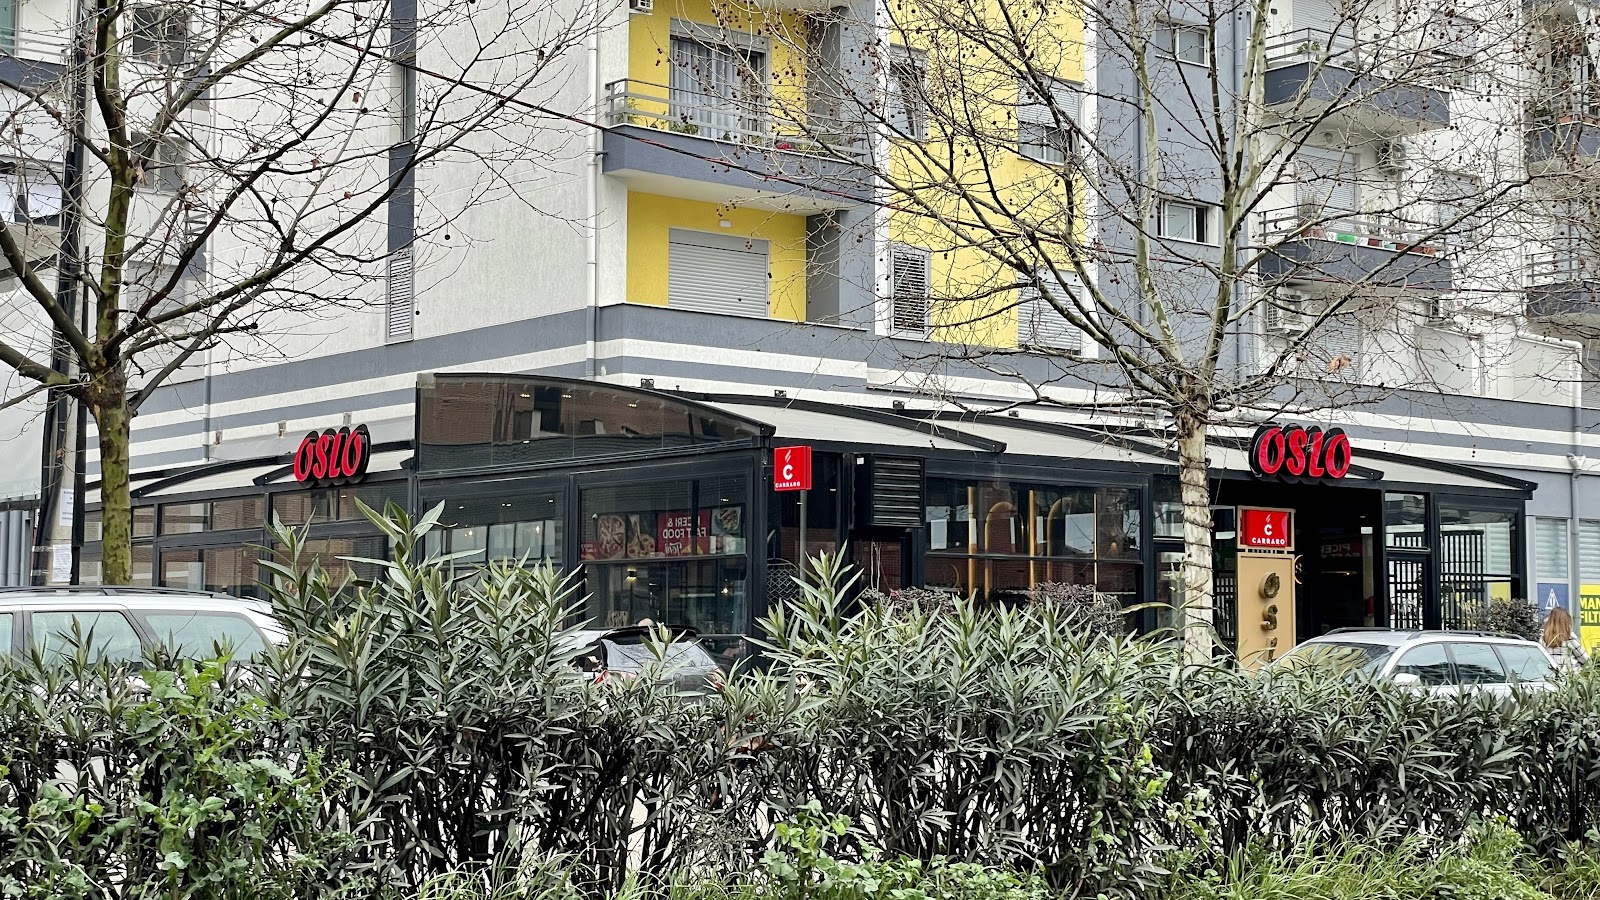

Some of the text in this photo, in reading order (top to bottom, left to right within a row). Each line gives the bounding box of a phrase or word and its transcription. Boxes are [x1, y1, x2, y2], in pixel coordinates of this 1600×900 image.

[293, 428, 365, 483] OSLO
[1257, 426, 1352, 479] OSLO
[782, 464, 793, 481] C
[774, 481, 801, 489] CARRARO
[1263, 523, 1273, 536] C
[1251, 536, 1286, 545] CARRARO
[1580, 611, 1600, 623] FILT
